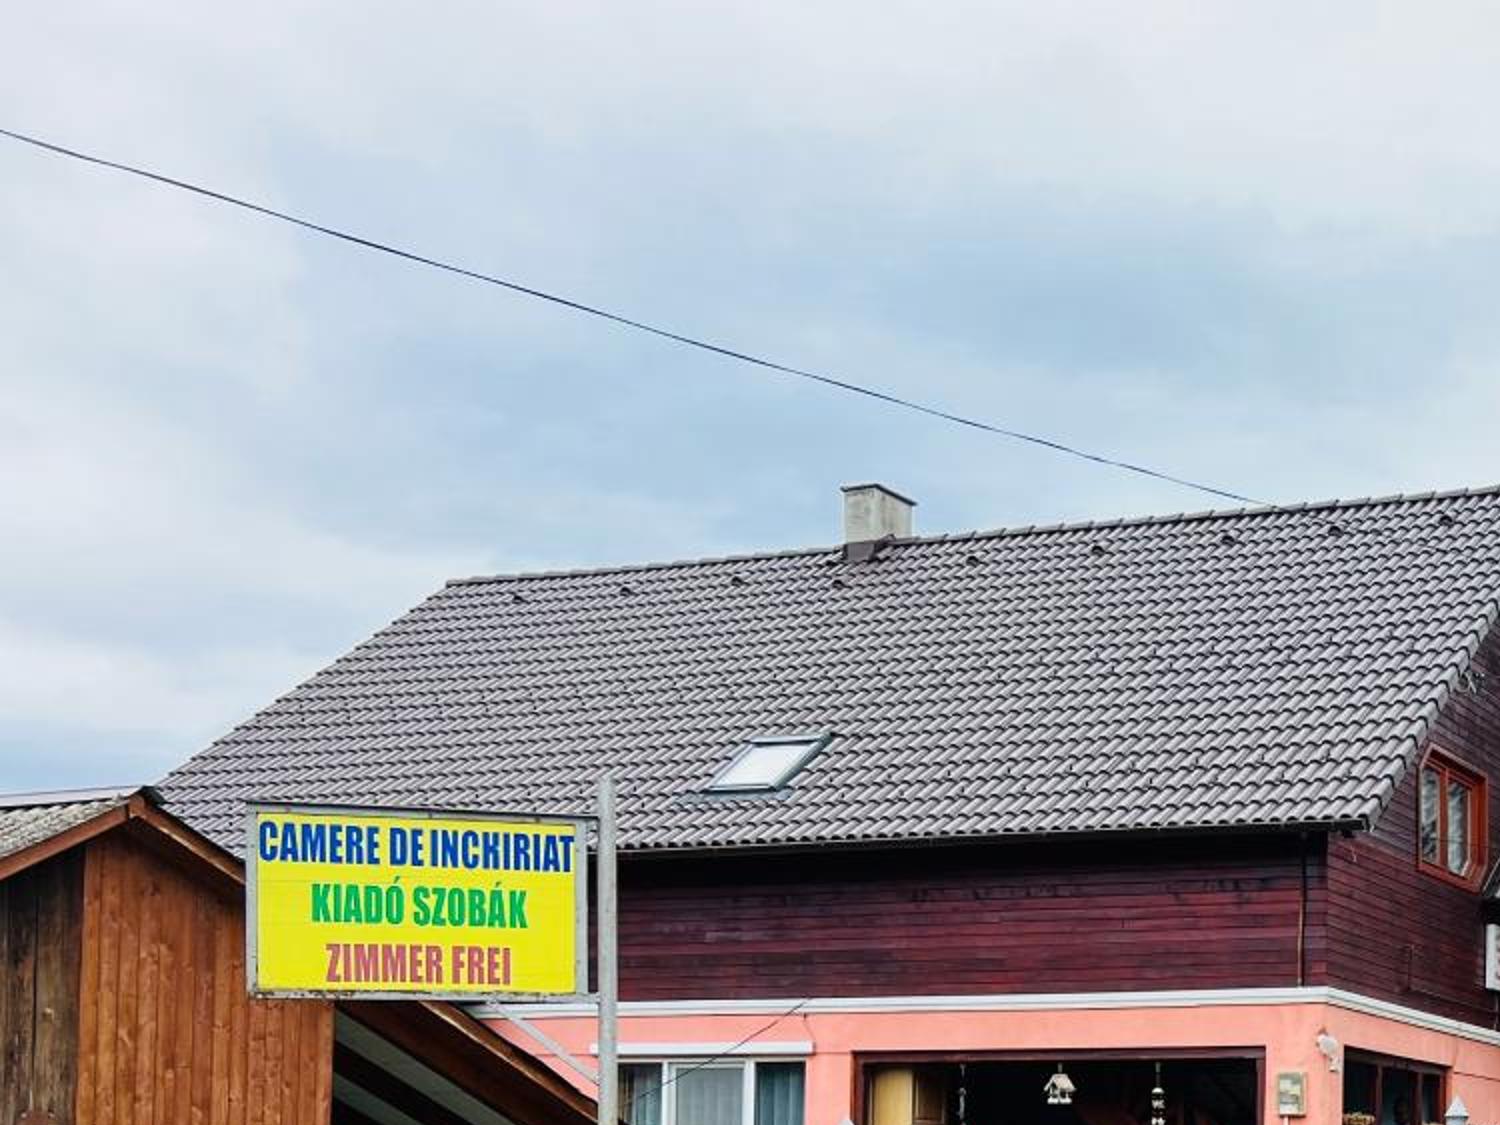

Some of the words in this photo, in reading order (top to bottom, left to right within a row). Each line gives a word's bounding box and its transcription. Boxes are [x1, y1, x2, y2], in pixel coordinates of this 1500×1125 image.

[258, 820, 380, 865] CAMERE
[389, 827, 424, 866] DE
[430, 830, 575, 872] INCHIRIAT
[311, 875, 405, 925] KIADÓ
[413, 882, 528, 928] SZOBÁK
[325, 943, 443, 984] ZIMMER
[452, 946, 511, 986] FREI
